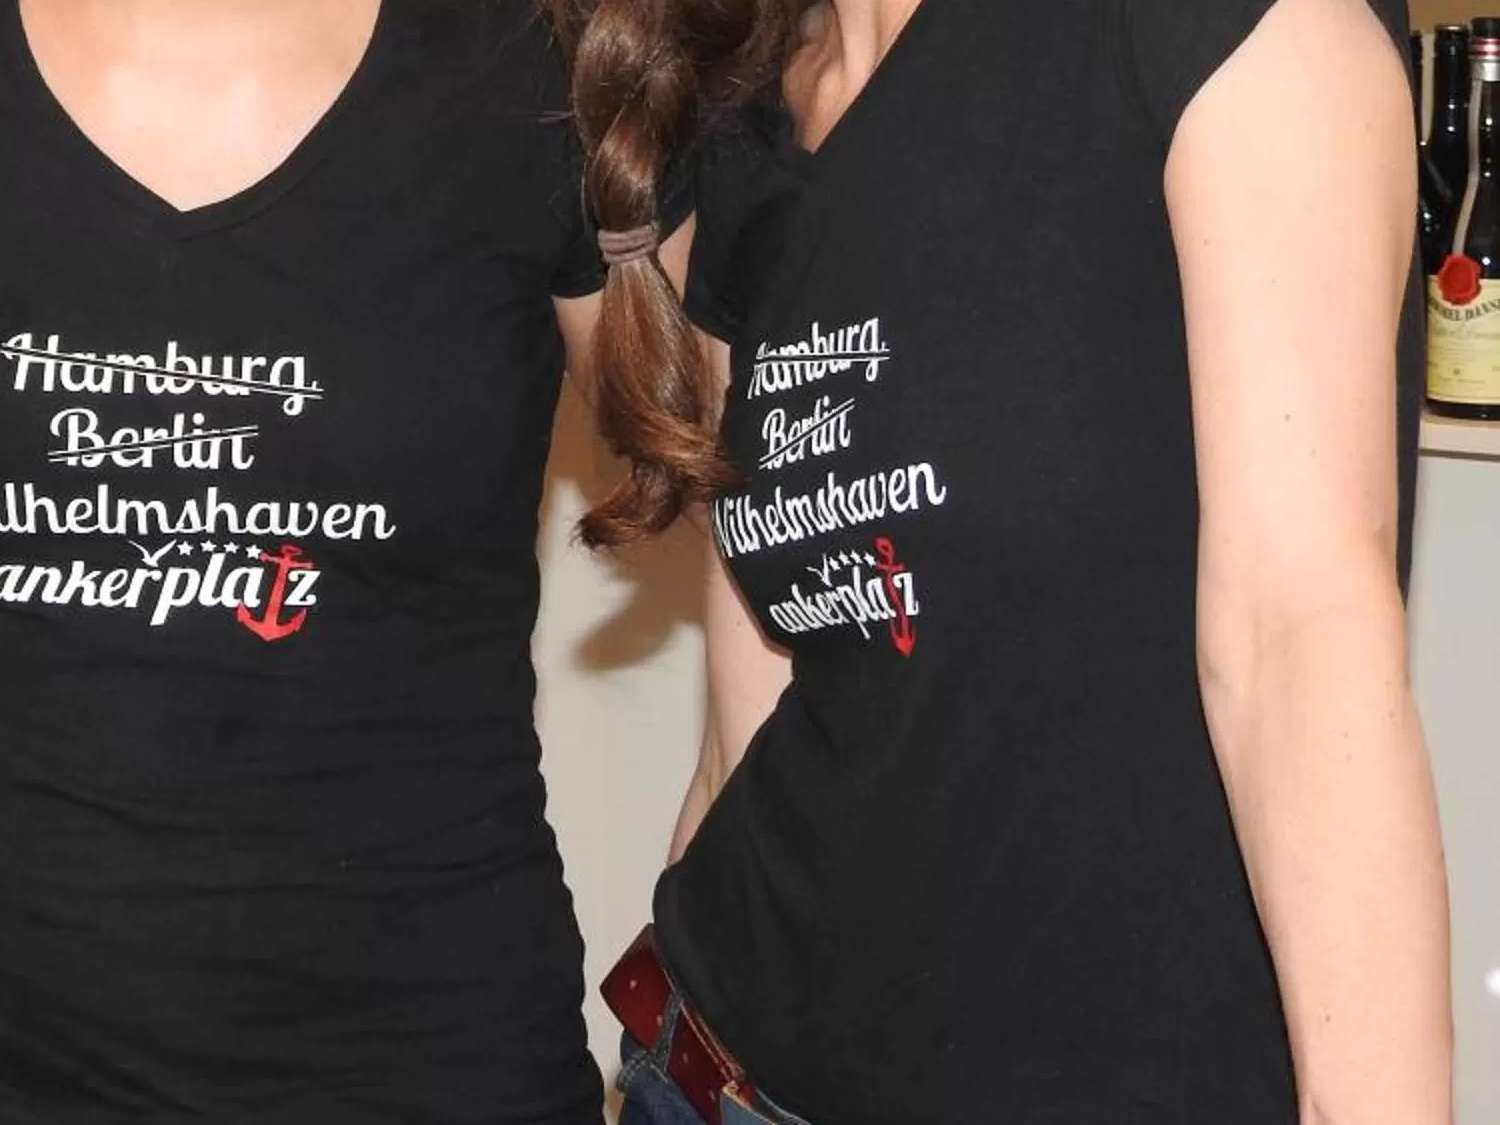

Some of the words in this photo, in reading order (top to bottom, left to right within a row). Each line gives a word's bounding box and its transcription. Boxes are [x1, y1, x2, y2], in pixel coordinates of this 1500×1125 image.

[1, 332, 324, 416] Hamburg
[49, 407, 259, 470] Berlin
[759, 395, 855, 471] Berlin
